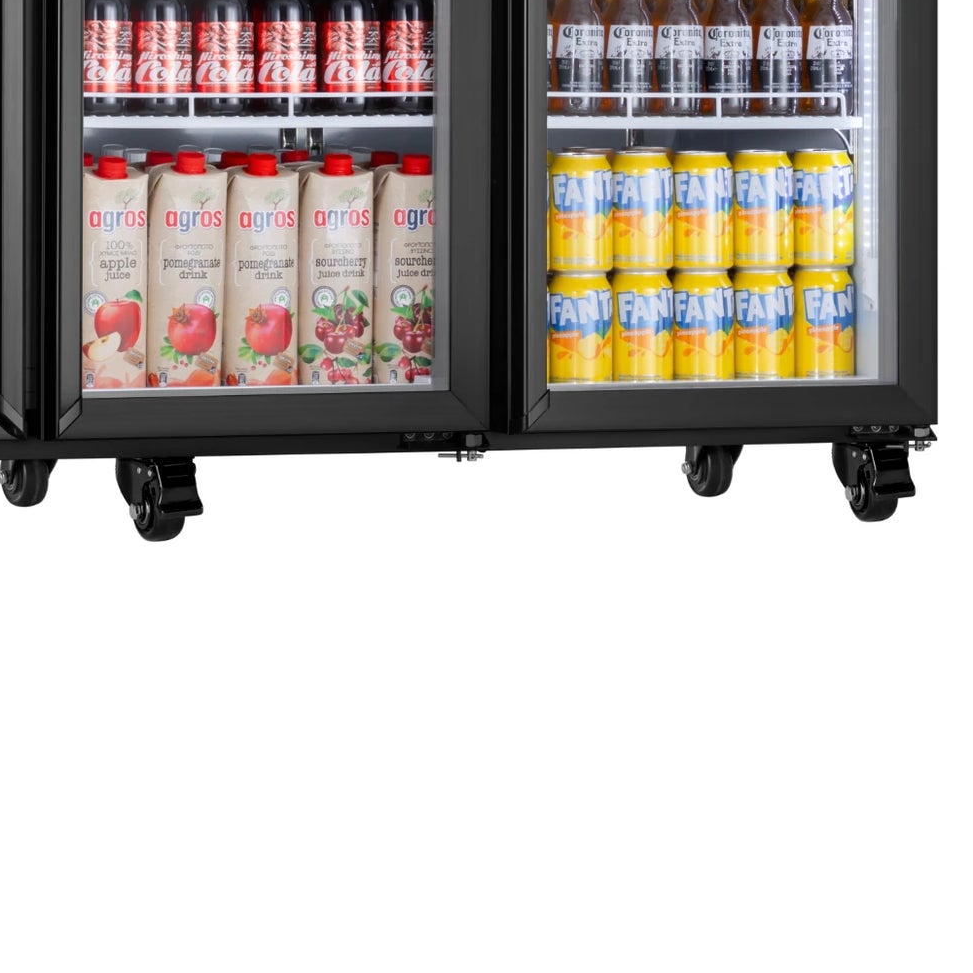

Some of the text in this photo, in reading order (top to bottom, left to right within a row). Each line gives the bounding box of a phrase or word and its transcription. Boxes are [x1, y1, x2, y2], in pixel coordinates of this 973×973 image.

[135, 60, 192, 84] Cola
[195, 61, 254, 84] Cola
[258, 60, 316, 84] Cola
[324, 60, 381, 84] Cola
[613, 168, 673, 205] FANT
[793, 165, 853, 202] FANT
[89, 210, 146, 232] agros
[165, 210, 223, 233] agros
[239, 211, 295, 233] agros
[313, 209, 370, 231] agros
[99, 257, 137, 271] apple
[163, 257, 221, 271] pomegranate
[239, 257, 295, 271] pomegranate
[315, 256, 367, 268] sourcherry
[104, 270, 131, 281] juice
[179, 270, 208, 279] drink
[255, 270, 283, 279] drink
[317, 269, 365, 279] juice drink
[397, 269, 419, 279] juice
[550, 289, 612, 326] FANT
[803, 284, 854, 321] FAN
